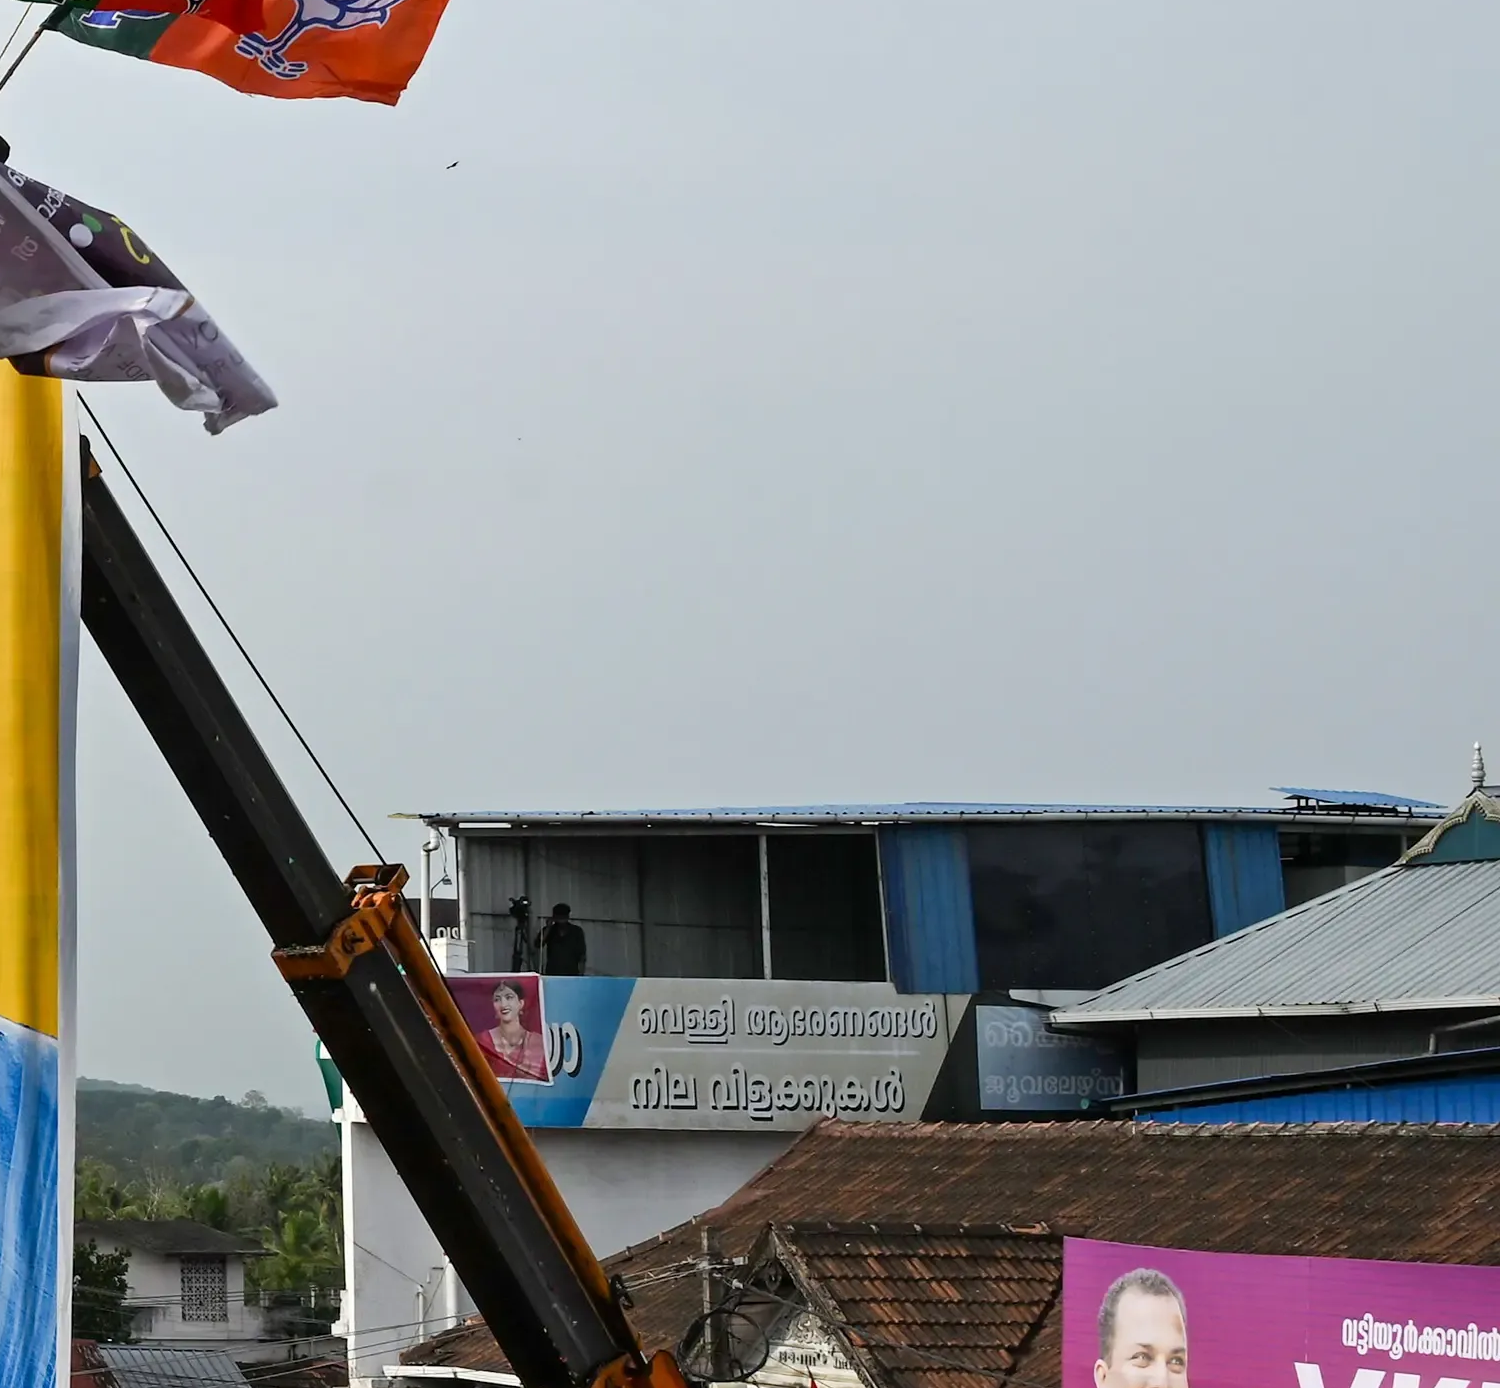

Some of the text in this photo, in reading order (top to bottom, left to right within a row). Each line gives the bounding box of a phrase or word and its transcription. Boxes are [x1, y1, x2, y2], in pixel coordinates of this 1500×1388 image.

[639, 997, 736, 1044] വെള്ളി
[744, 998, 938, 1045] ആഭരണങ്ങൾ
[630, 1059, 905, 1121] നില വിളക്കുകൾ
